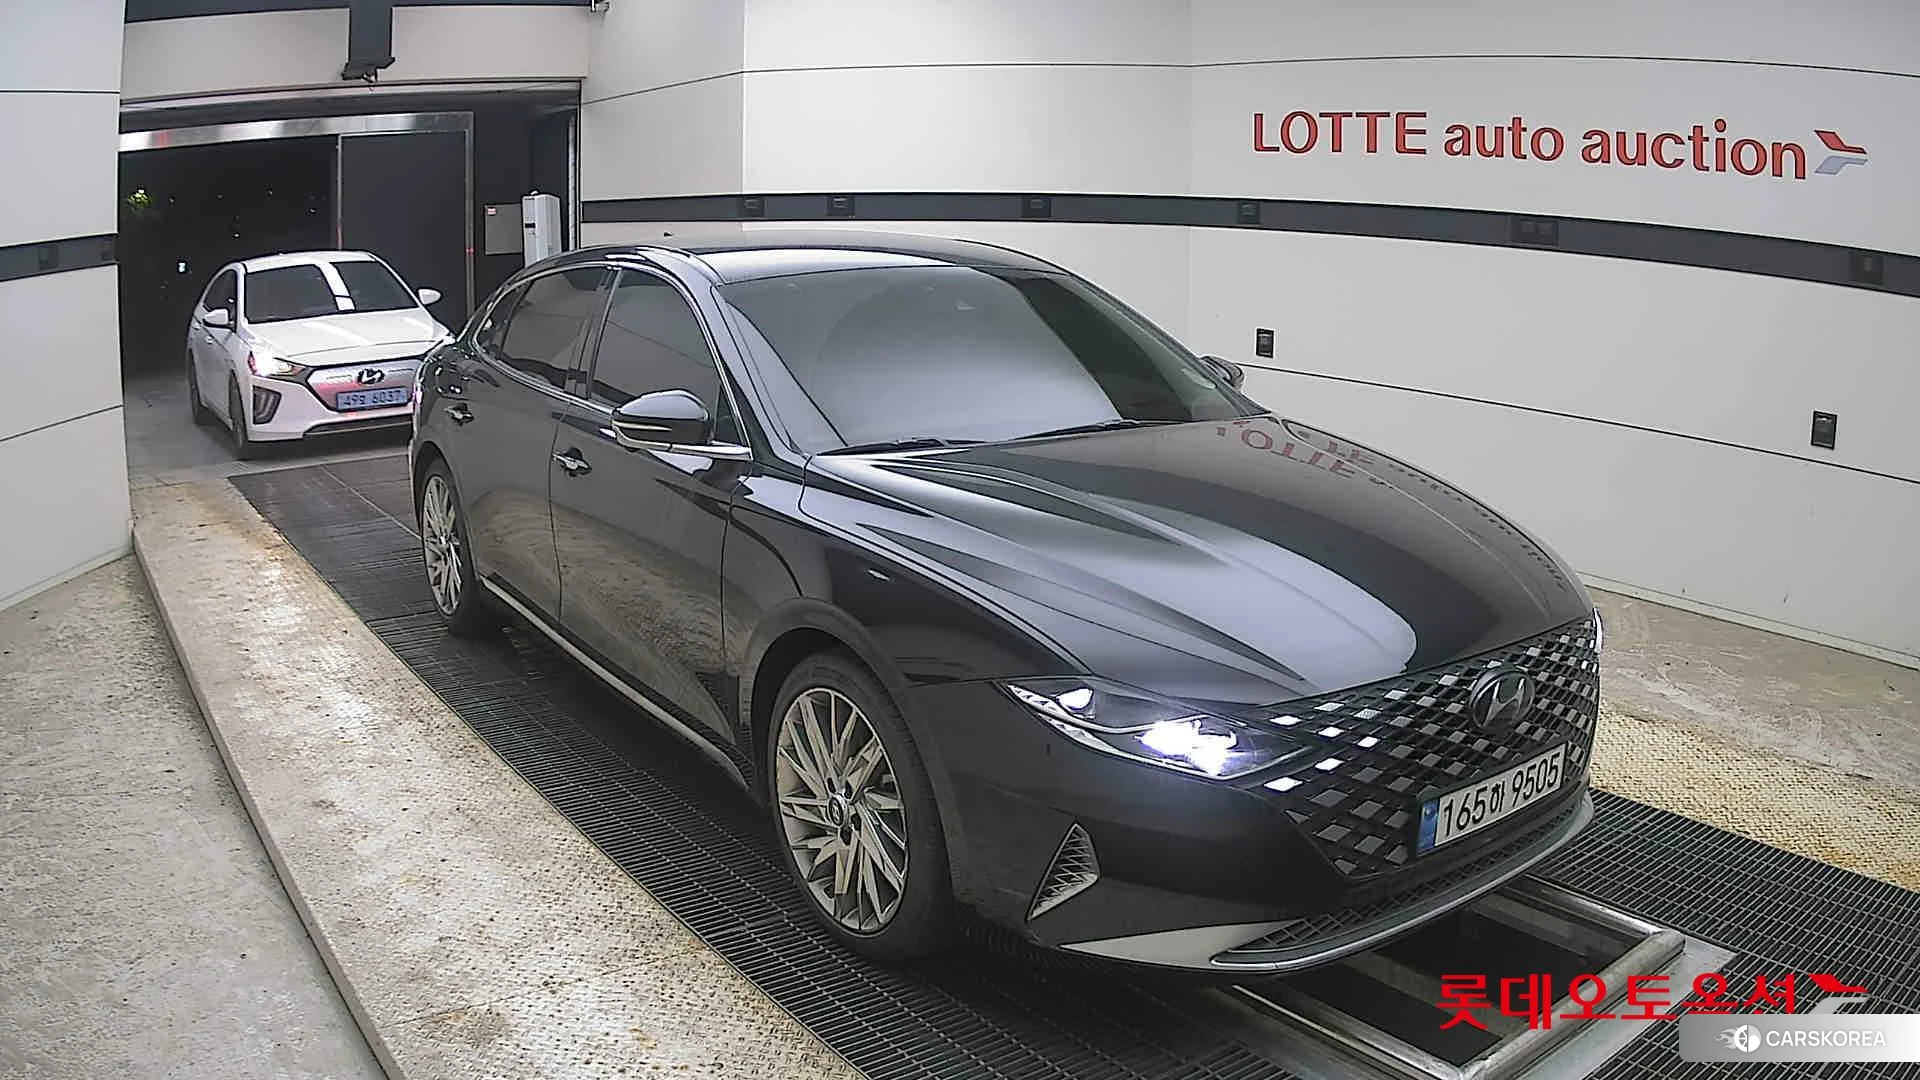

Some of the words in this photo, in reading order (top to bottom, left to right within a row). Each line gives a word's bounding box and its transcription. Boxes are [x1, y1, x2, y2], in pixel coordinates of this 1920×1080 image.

[1253, 111, 1427, 155] LOTTE
[1444, 116, 1566, 161] auto
[1581, 119, 1807, 180] auction
[1511, 751, 1562, 808] 9505
